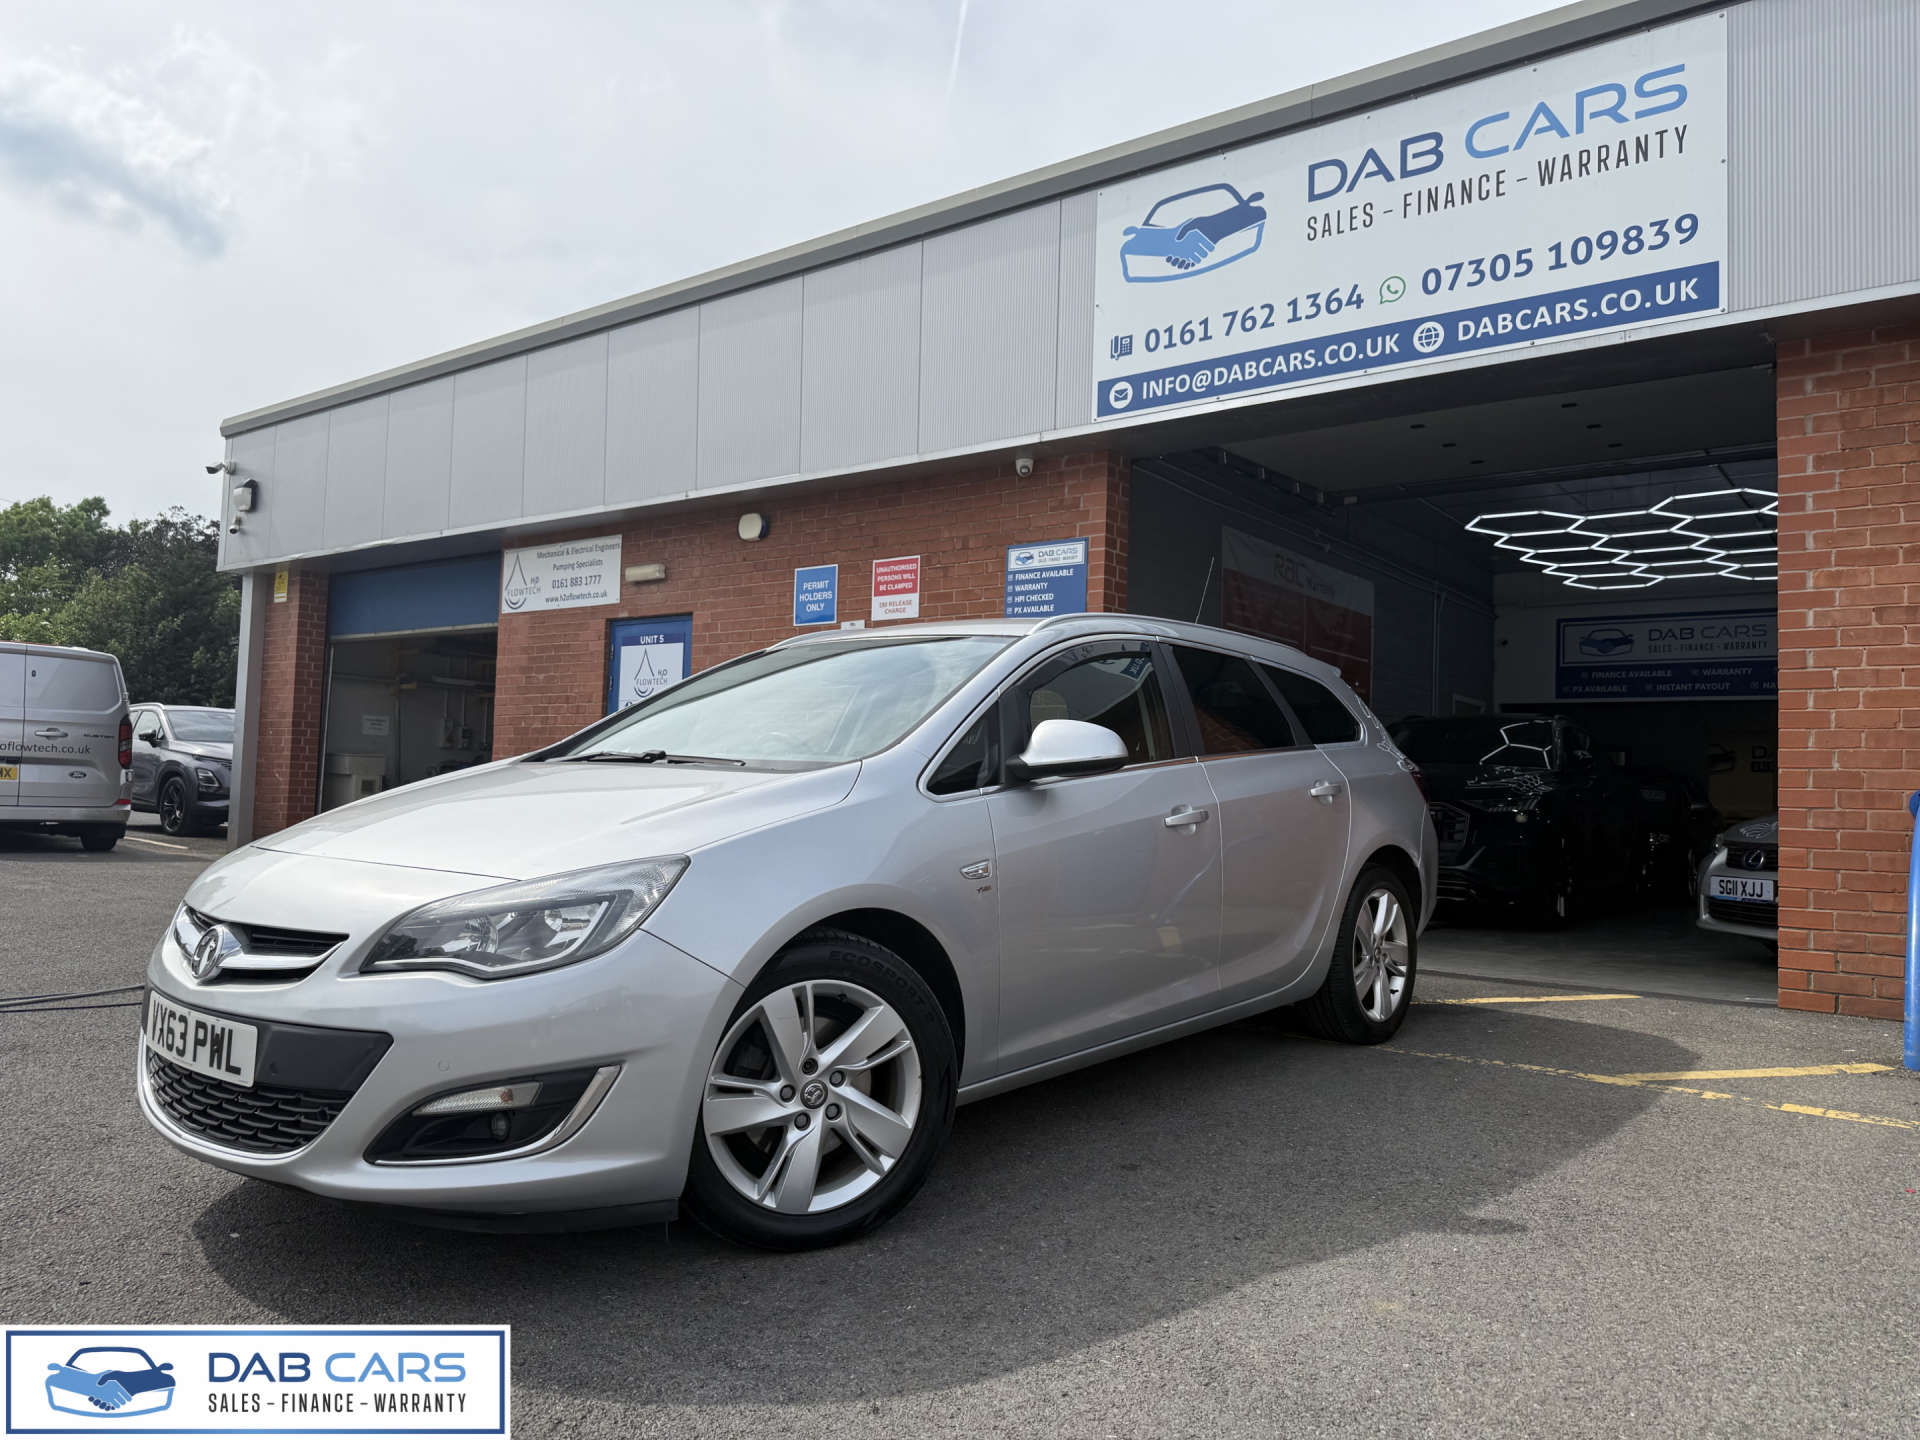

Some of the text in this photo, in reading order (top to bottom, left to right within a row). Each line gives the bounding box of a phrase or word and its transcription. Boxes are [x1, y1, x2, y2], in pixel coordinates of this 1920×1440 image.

[1308, 64, 1689, 202] DAB CARS
[1307, 203, 1375, 241] SALES
[1403, 170, 1506, 218] FINANCE
[1538, 124, 1689, 187] WARRANTY
[1144, 213, 1699, 353] 0161 762 1364 07305 109839
[1142, 278, 1699, 401] INFO@DABCARS.CO.UK DABCARS.CO.UK
[552, 562, 575, 571] Pumping
[878, 574, 902, 582] PERSONS
[1015, 568, 1074, 581] FINANCE AVAILABLE
[552, 579, 568, 589] 0161
[585, 574, 602, 586] 1777
[803, 580, 830, 591] PERMIT
[887, 582, 912, 590] CLAMPED
[1014, 582, 1048, 592] WARRANTY
[507, 586, 541, 598] FLOWTECH
[799, 591, 833, 602] HOLDERS
[1026, 593, 1054, 602] CHECKED
[806, 602, 825, 613] ONLY
[1023, 604, 1055, 614] AVAILABLE
[1648, 623, 1768, 641] DAB CARS
[640, 634, 665, 645] UNIT 5
[1591, 667, 1753, 679] FINANCE AVAILABLE WARRANTY
[636, 678, 668, 686] FLOWTECH
[1656, 683, 1693, 691] INSTANT
[1694, 682, 1731, 690] PAYOUT
[0, 768, 12, 778] X
[1740, 881, 1764, 898] XJJ
[151, 999, 242, 1076] VX63 PWL
